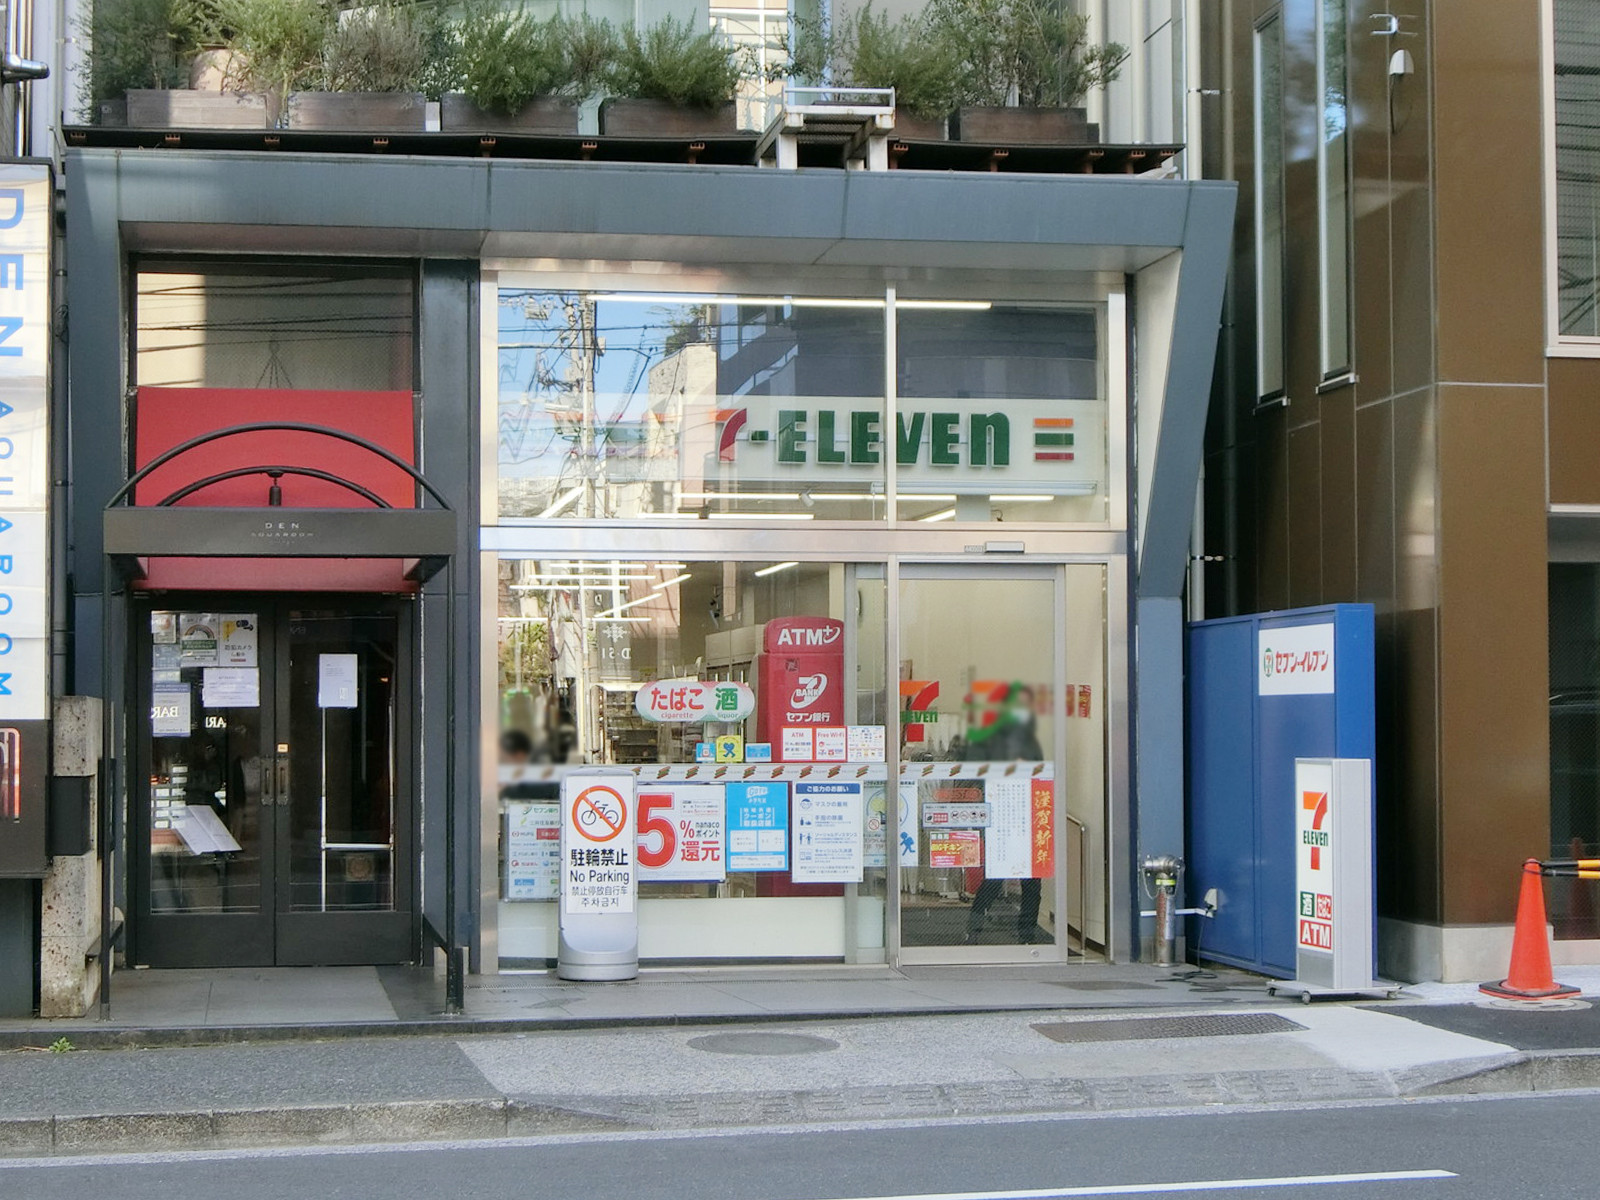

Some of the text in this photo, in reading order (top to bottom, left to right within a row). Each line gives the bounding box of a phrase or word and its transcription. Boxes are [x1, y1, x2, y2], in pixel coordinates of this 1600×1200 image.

[650, 686, 738, 711] たばこ 酒
[786, 711, 831, 723] セブン銀行
[637, 793, 676, 868] 5
[696, 830, 720, 838] ポイント
[570, 848, 629, 867] 駐輪禁止
[681, 841, 720, 862] 還元
[569, 869, 630, 885] No Parking
[1302, 893, 1314, 917] 酒
[1301, 922, 1331, 950] ATM
